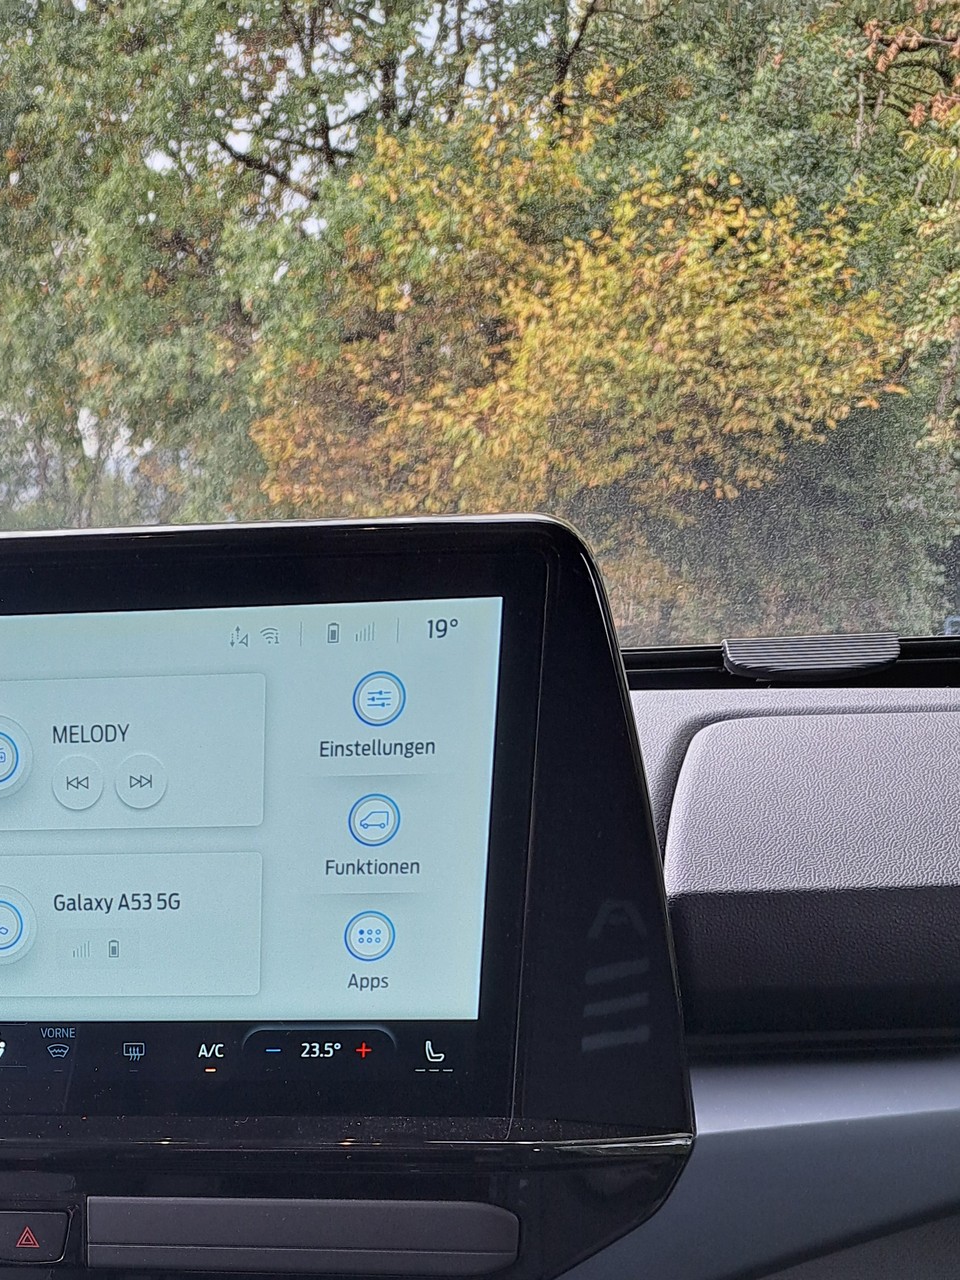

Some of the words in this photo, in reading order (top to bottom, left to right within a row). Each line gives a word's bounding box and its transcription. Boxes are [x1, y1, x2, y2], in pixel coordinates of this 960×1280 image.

[427, 619, 459, 639] 19°
[52, 724, 130, 745] MELODY
[319, 739, 436, 759] Einstellungen
[324, 859, 421, 877] Funktionen
[53, 893, 114, 915] Galaxy
[117, 893, 152, 911] A53
[156, 892, 181, 911] 5G
[347, 972, 389, 991] Apps
[40, 1027, 76, 1039] VORNE
[198, 1043, 225, 1059] A/C
[300, 1042, 342, 1059] 23.5°
